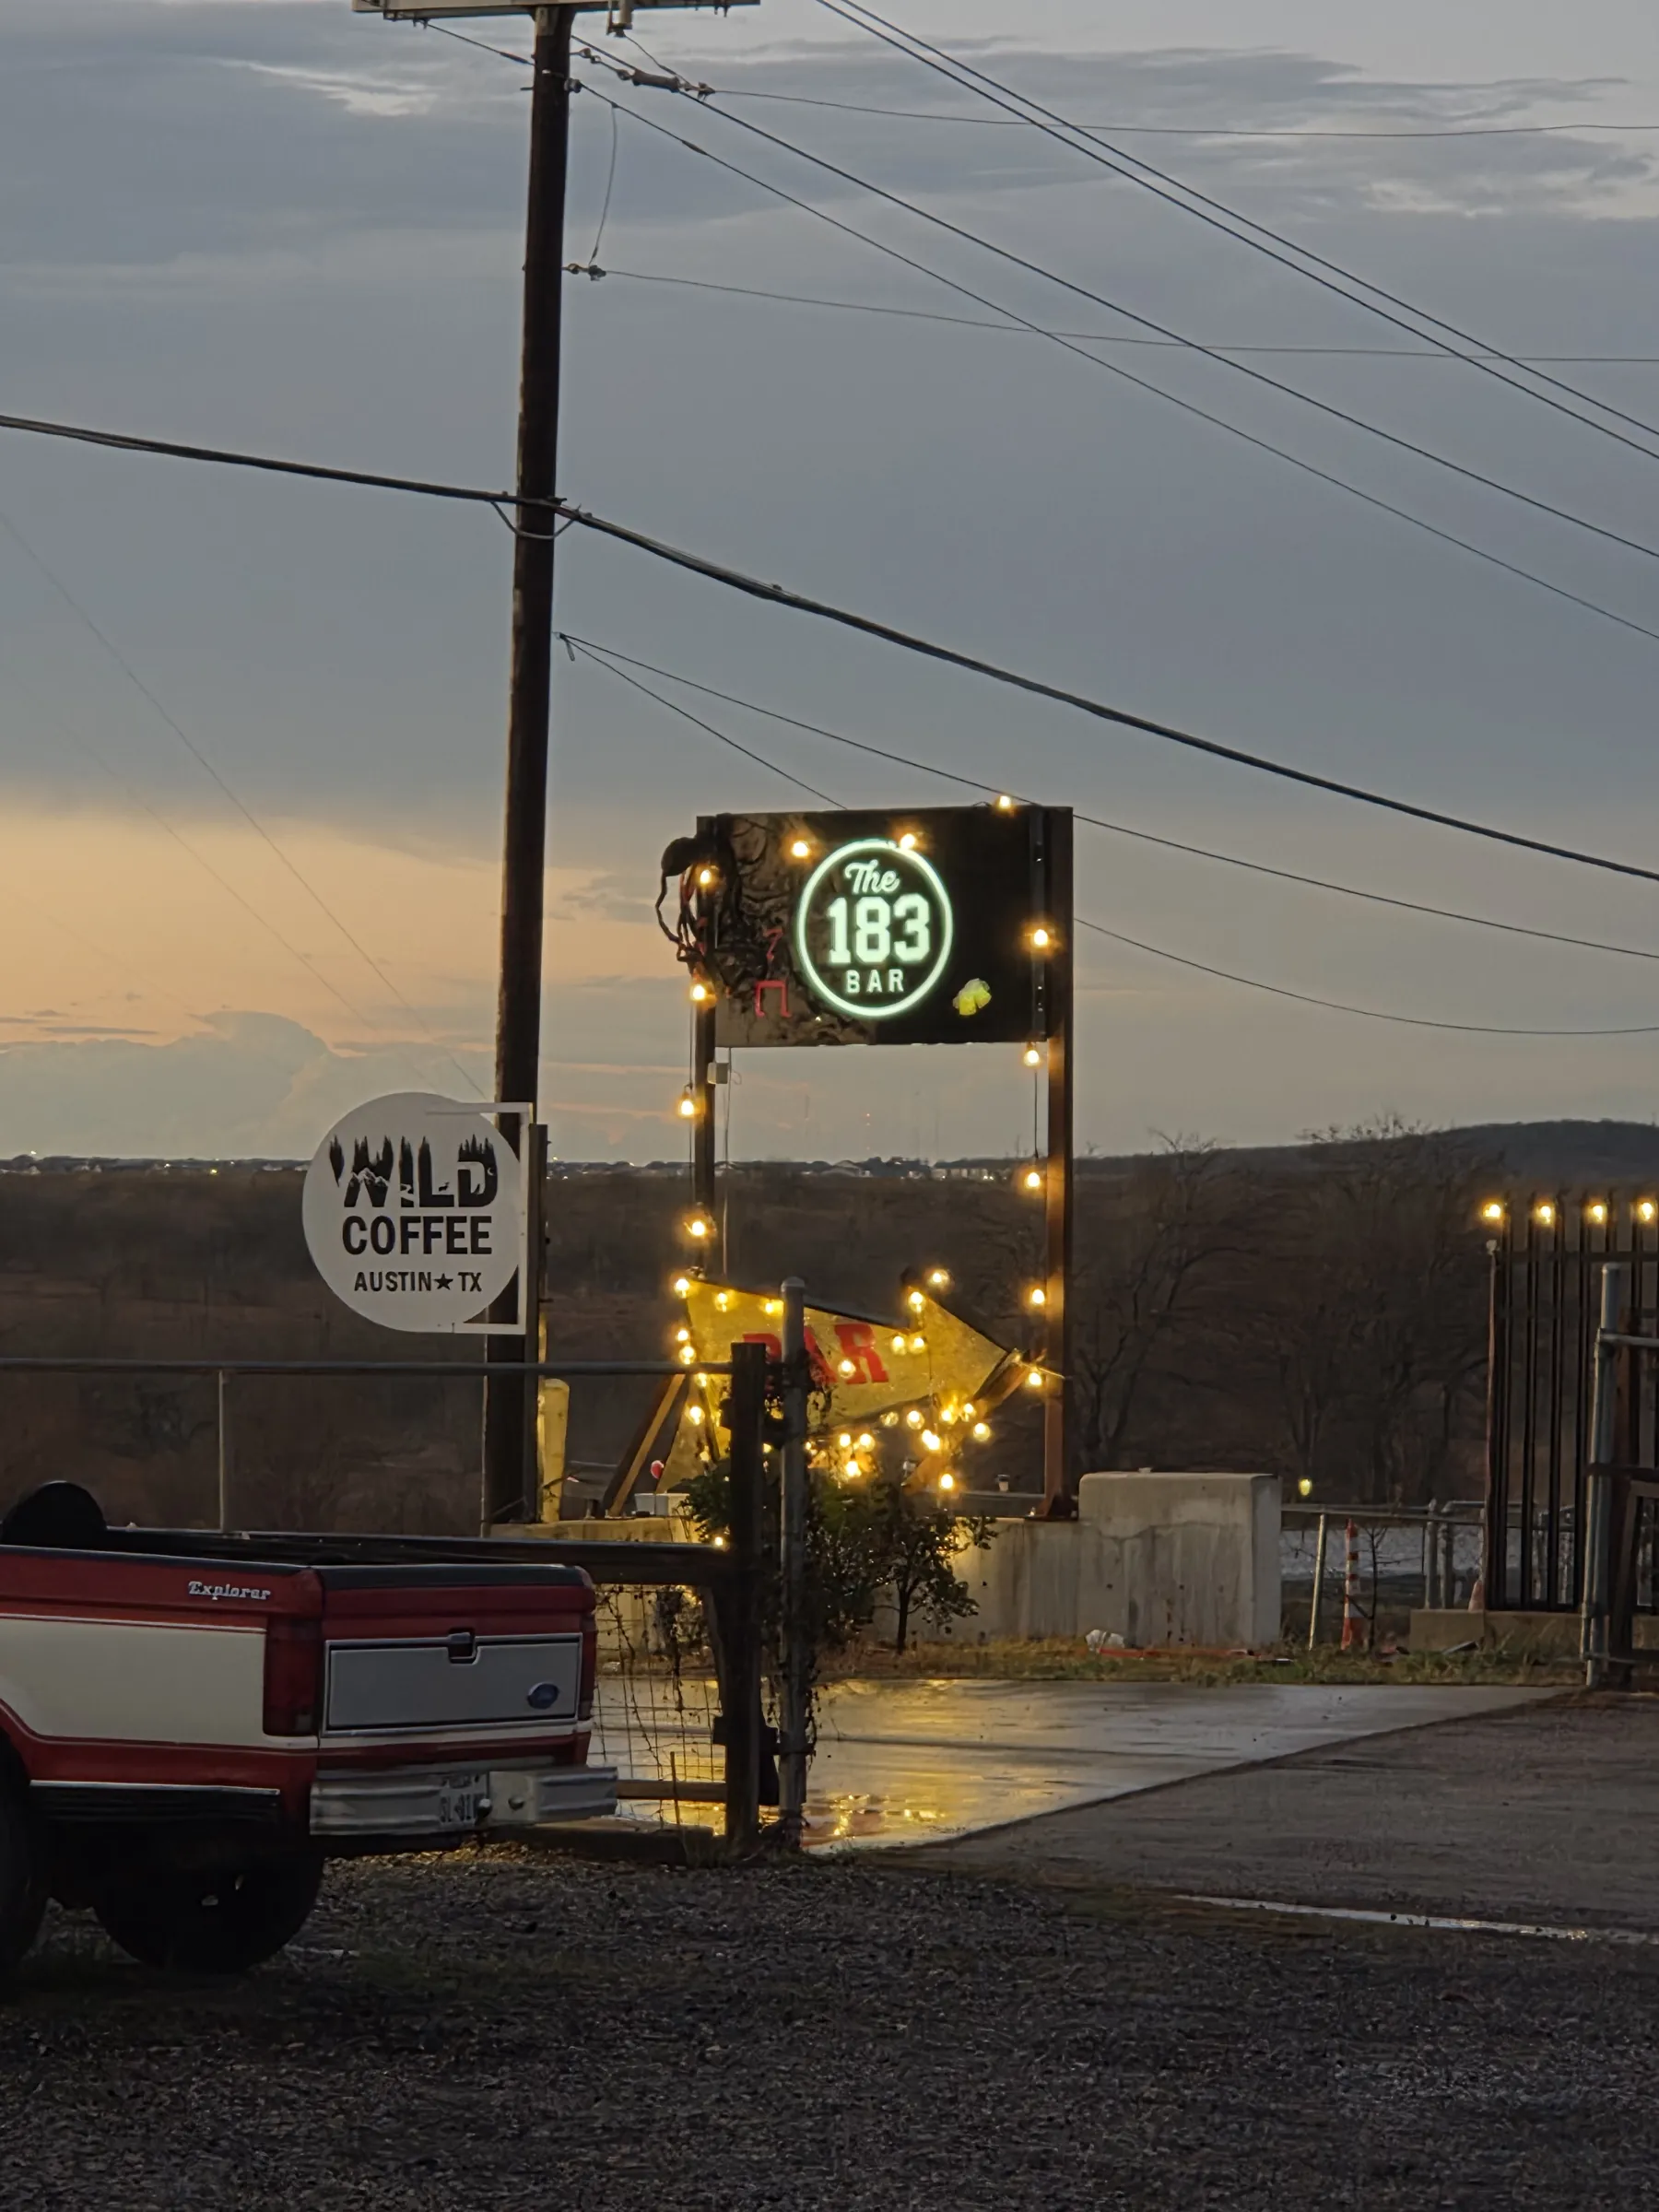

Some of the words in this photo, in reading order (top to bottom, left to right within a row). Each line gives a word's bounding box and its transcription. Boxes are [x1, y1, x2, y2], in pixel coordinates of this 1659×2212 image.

[844, 859, 900, 895] The
[827, 893, 930, 964] 183
[846, 968, 904, 994] BAR
[329, 1134, 498, 1207] WILD
[342, 1215, 492, 1255] COFFEE
[354, 1271, 431, 1292] AUSTIN
[458, 1272, 482, 1292] TX
